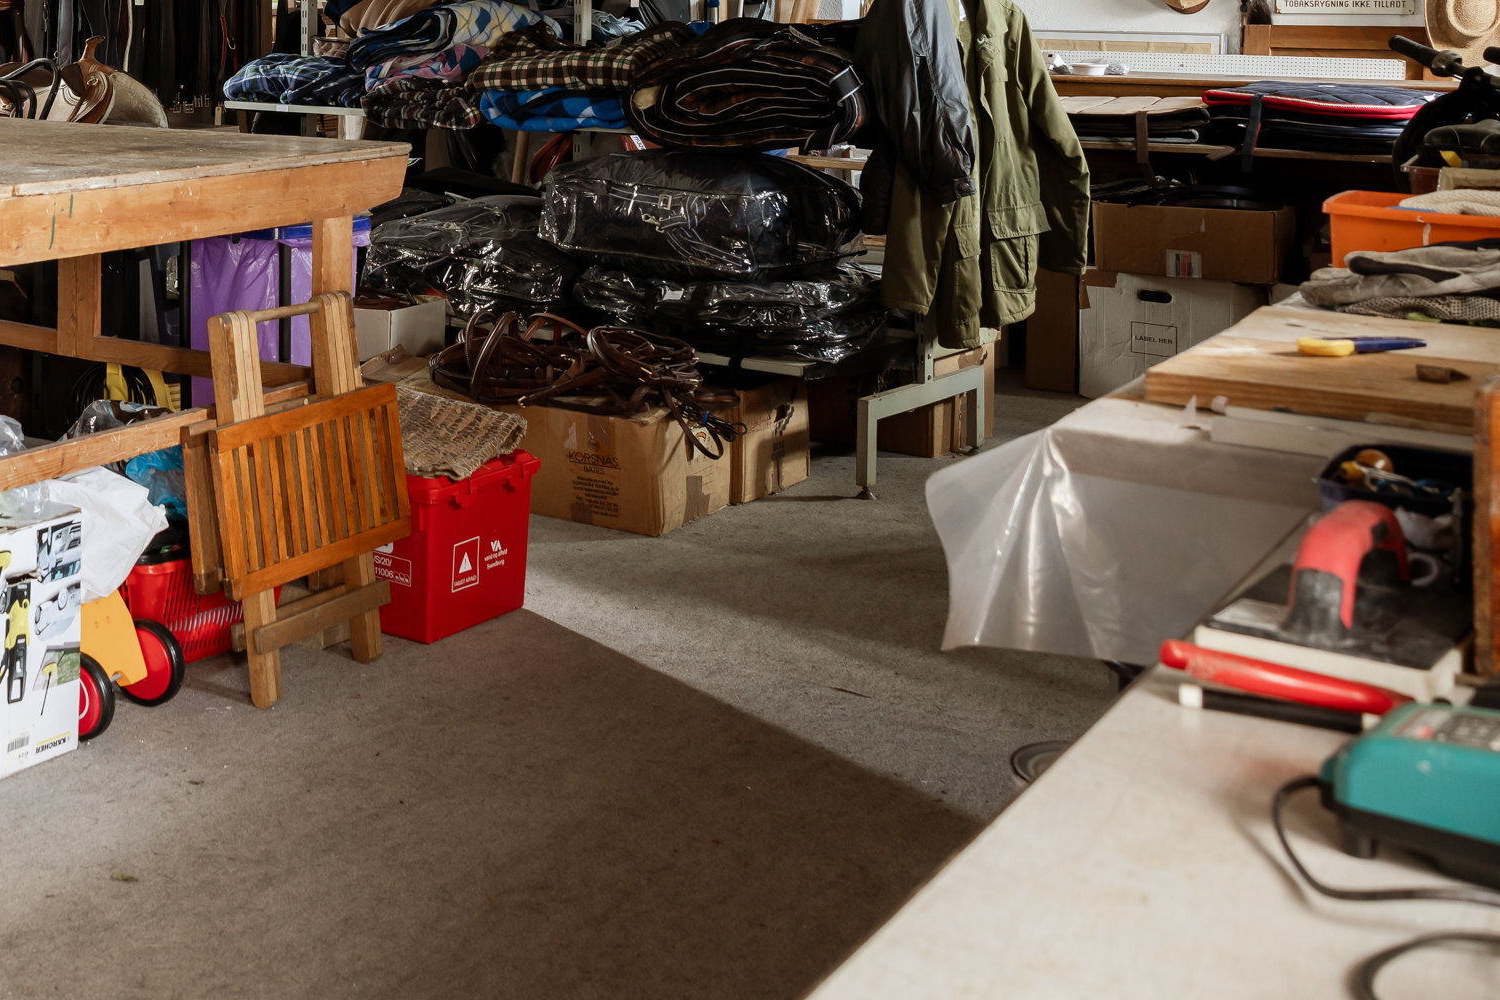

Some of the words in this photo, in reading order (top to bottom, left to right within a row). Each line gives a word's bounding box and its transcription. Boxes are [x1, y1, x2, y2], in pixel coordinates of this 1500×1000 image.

[1285, 0, 1349, 8] TOBAKSRYGNING
[1352, 0, 1370, 8] IKKE
[1374, 0, 1407, 8] TILLADT
[1135, 335, 1157, 343] LABEL
